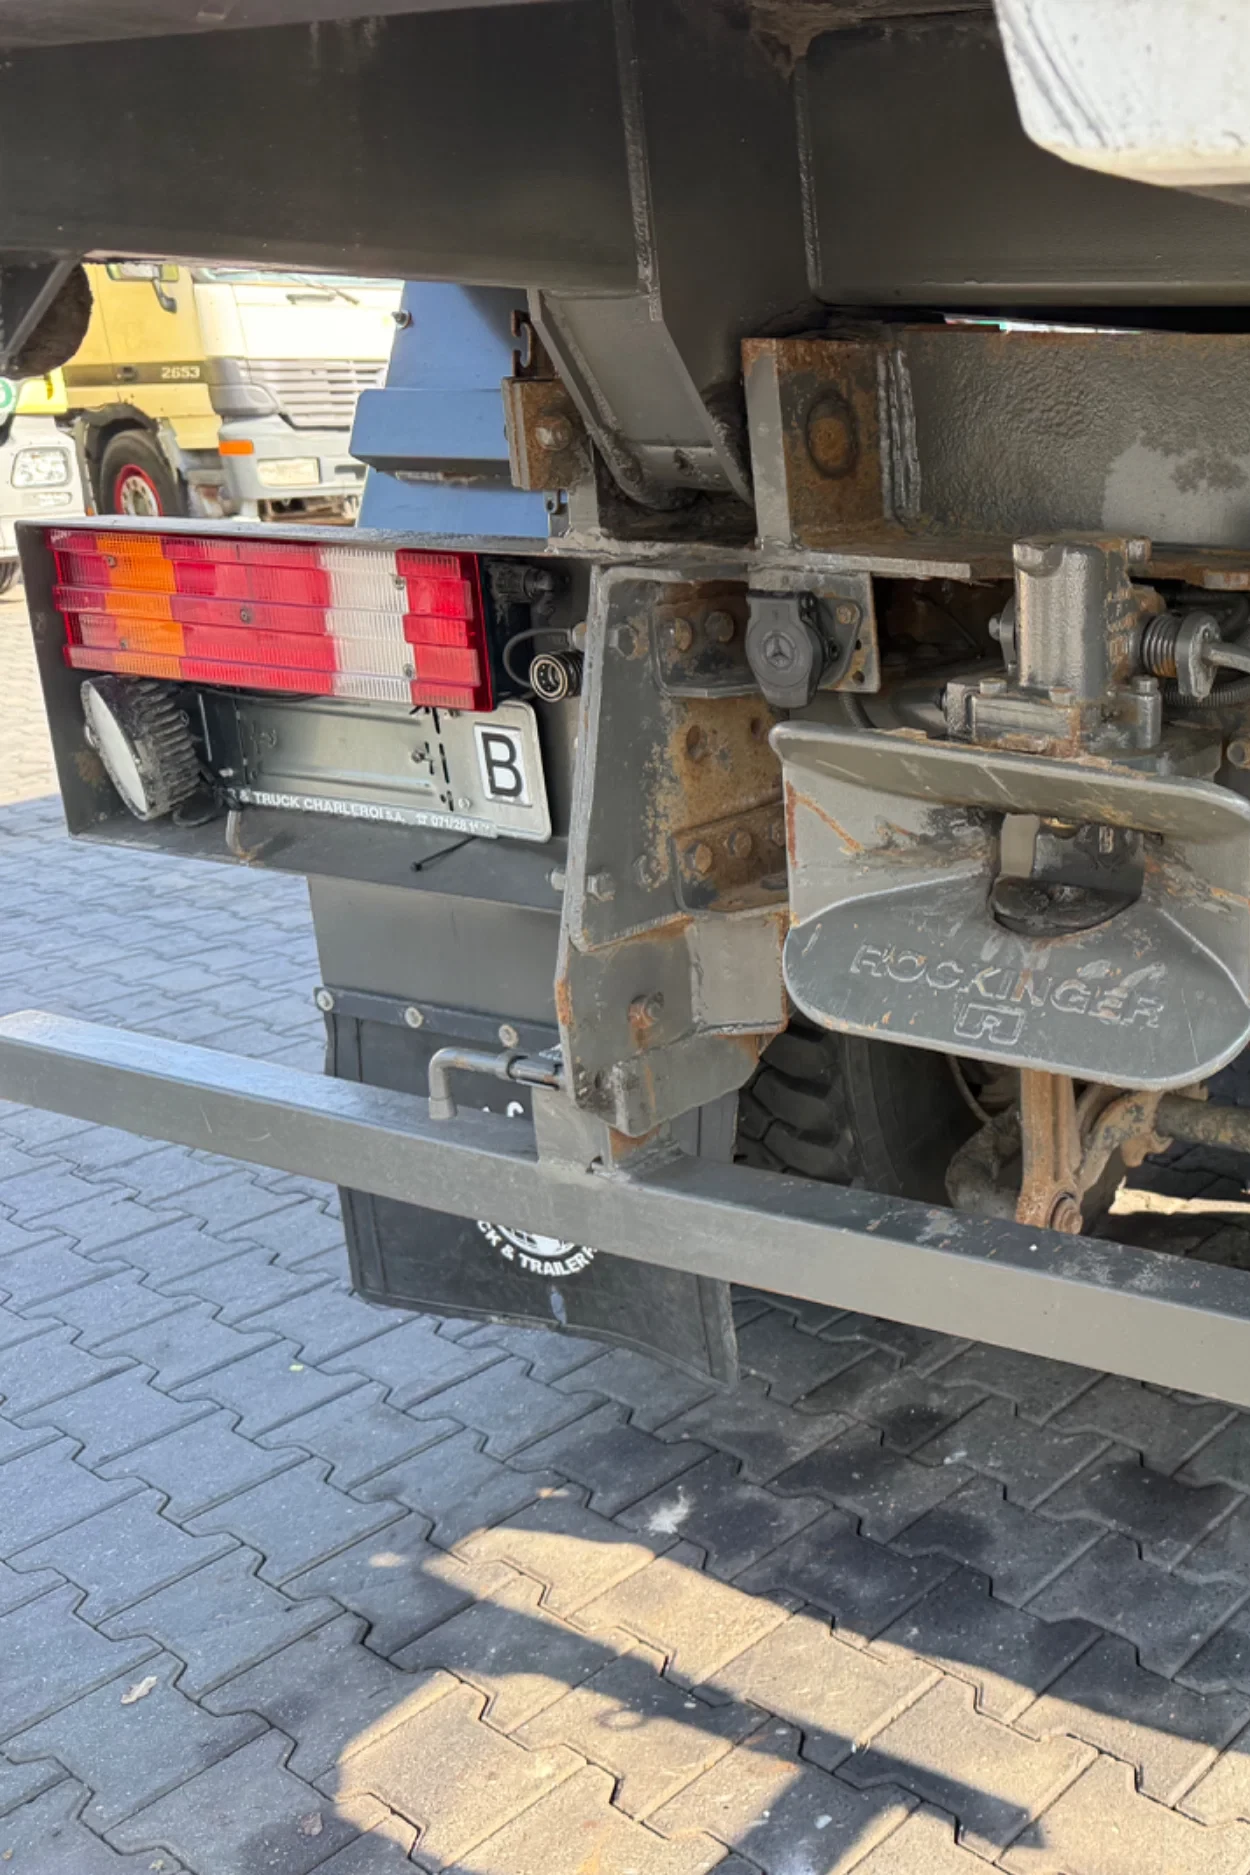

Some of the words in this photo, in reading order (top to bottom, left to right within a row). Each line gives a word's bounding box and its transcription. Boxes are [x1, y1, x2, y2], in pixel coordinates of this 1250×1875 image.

[161, 365, 200, 379] 2653
[481, 731, 523, 797] B
[253, 791, 300, 808] TRUCK
[303, 798, 383, 820] CHARLEROI
[850, 944, 1167, 1029] ROCKINGER
[518, 1252, 591, 1277] TRAILER
